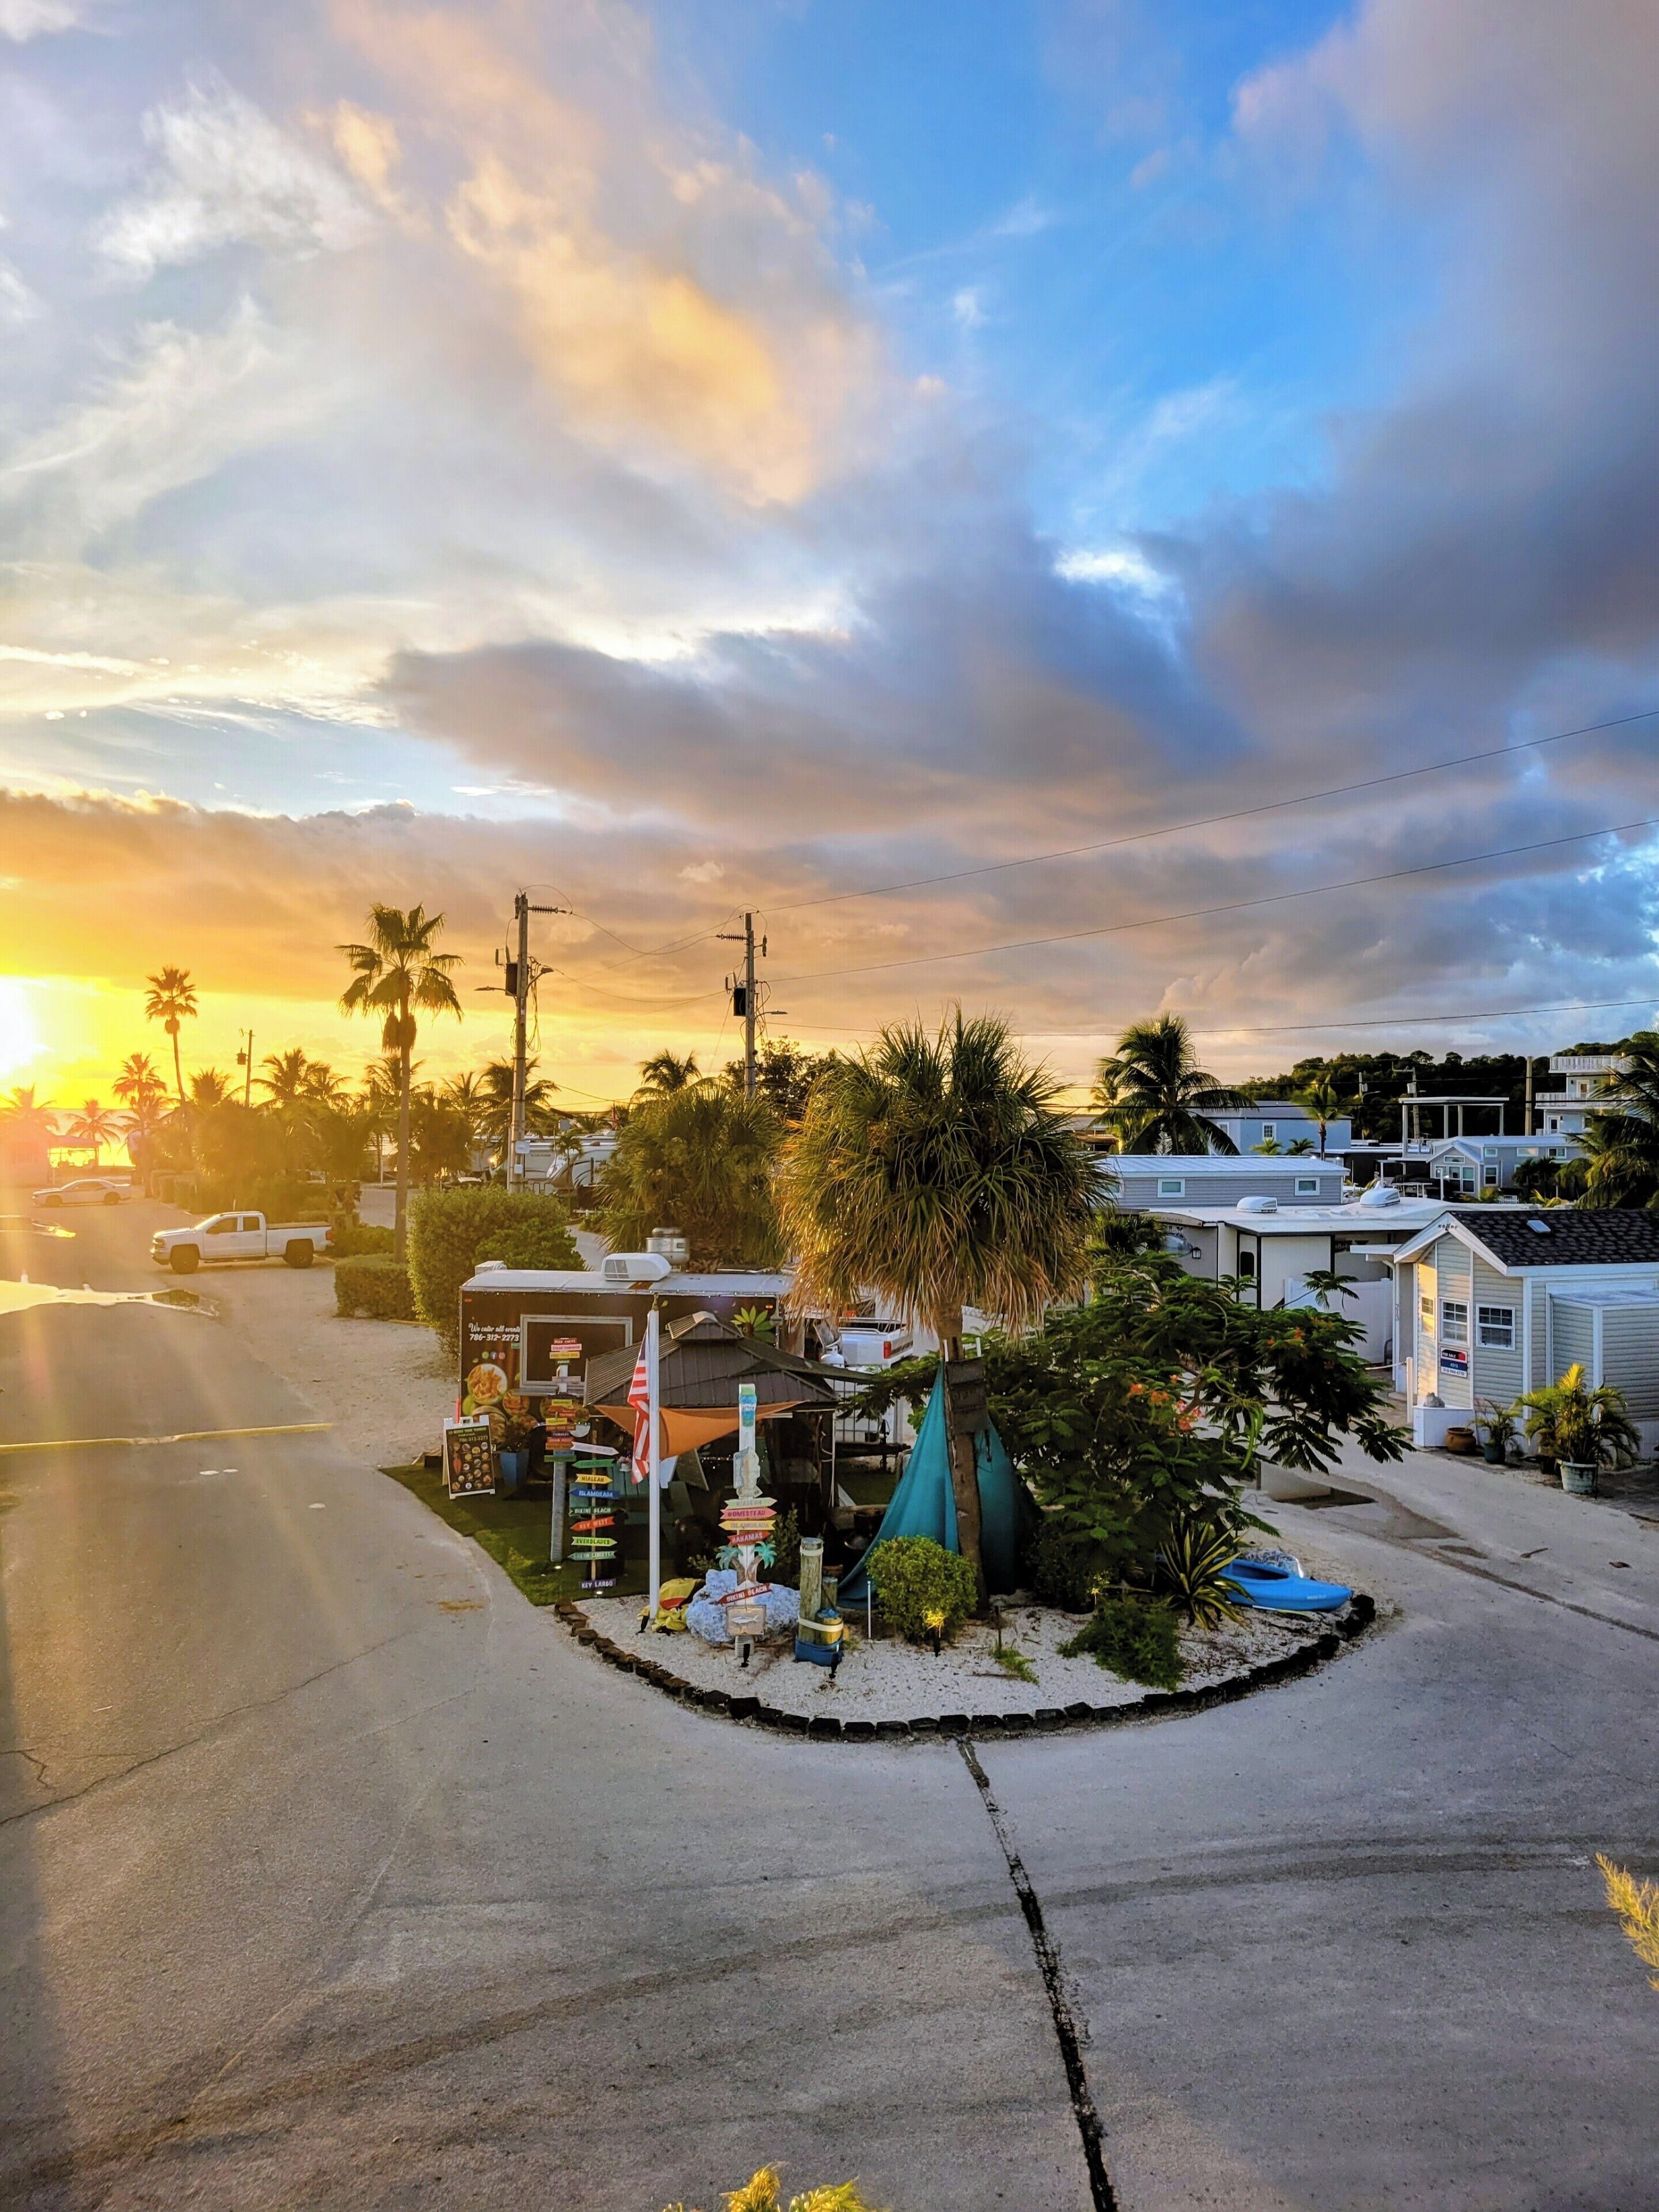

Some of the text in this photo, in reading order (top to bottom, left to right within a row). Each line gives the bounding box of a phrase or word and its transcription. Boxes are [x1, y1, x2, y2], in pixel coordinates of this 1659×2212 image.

[468, 1322, 480, 1332] We
[732, 1532, 763, 1544] BAHAMAS
[726, 1585, 767, 1601] BIKINI BEACH
